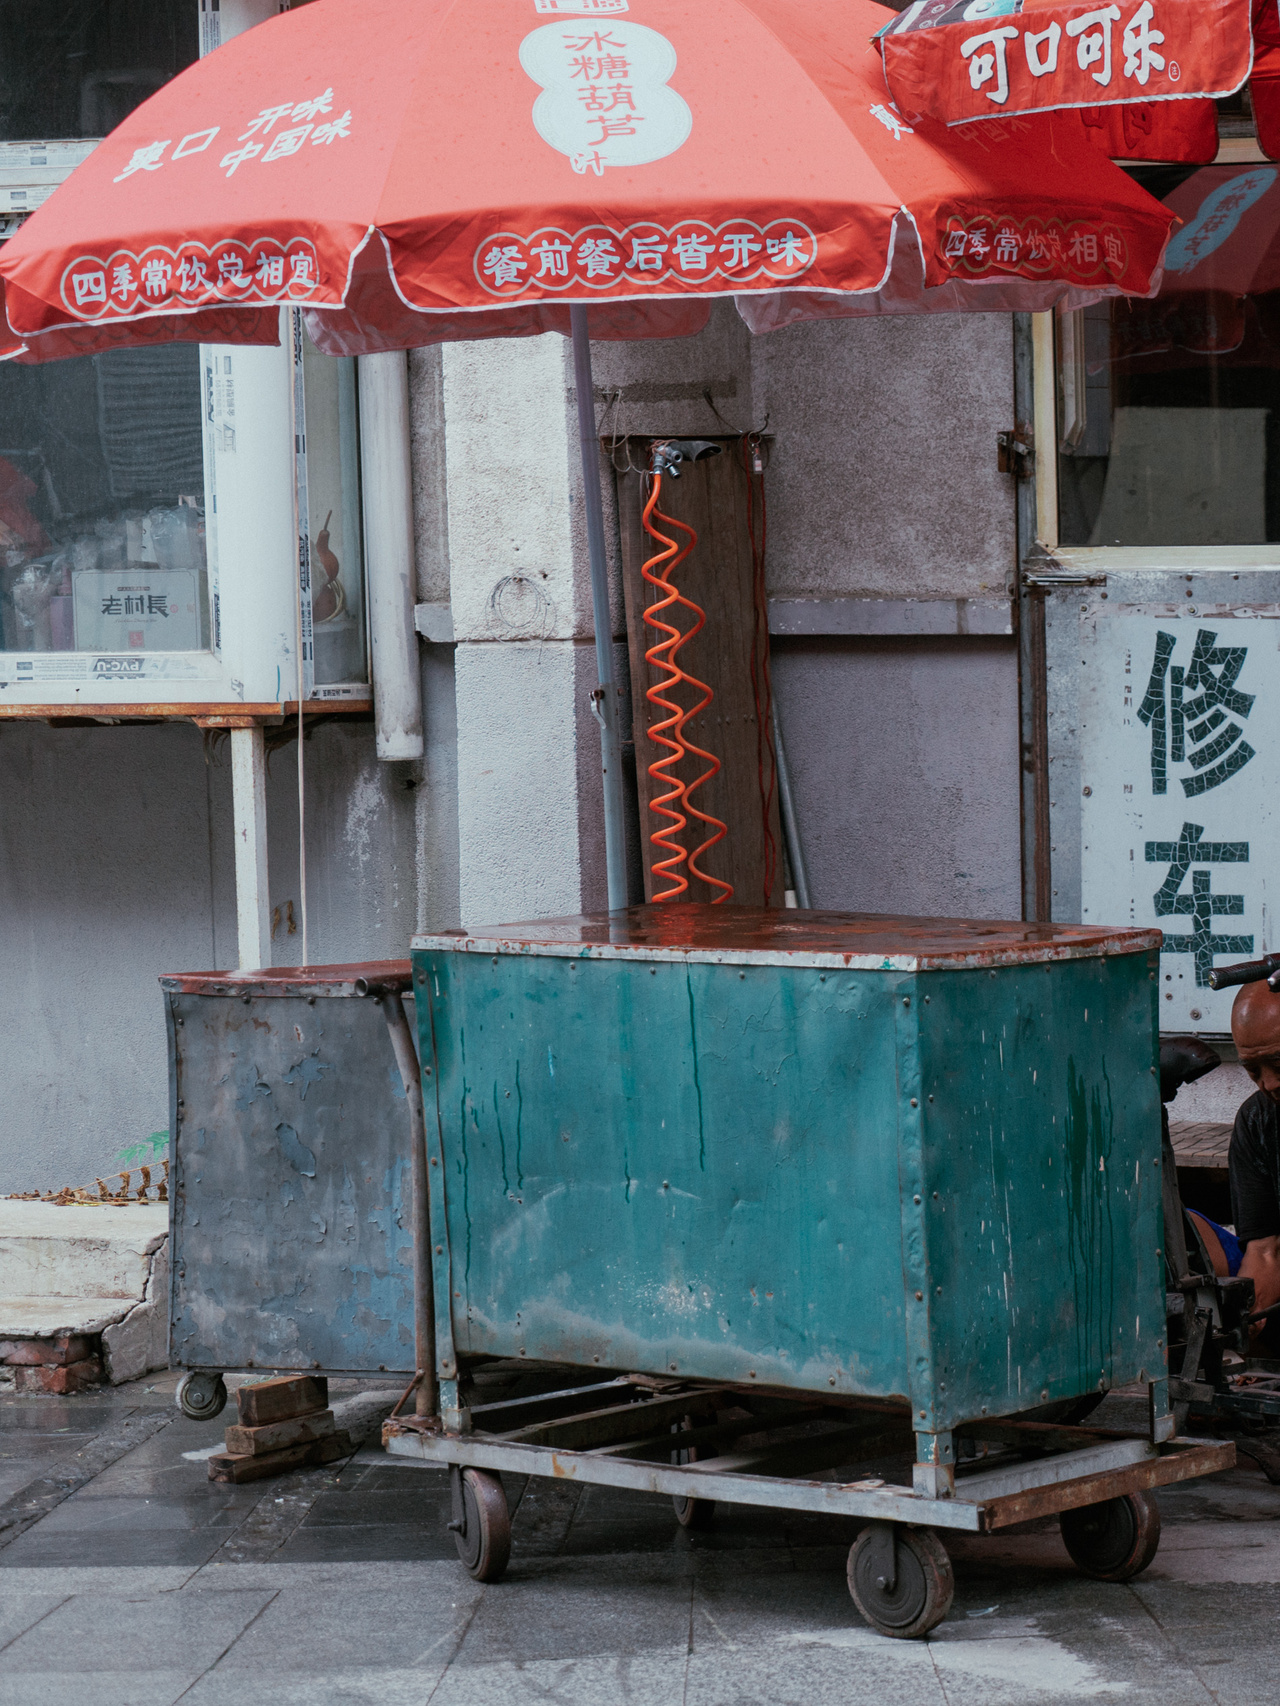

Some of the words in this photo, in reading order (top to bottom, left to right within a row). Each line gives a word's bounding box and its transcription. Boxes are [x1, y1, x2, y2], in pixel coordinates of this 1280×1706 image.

[960, 1, 1165, 104] 可口可乐
[238, 87, 334, 141] 开味
[113, 126, 220, 182] 爽口
[219, 110, 352, 177] 中国味
[71, 250, 320, 306] 四季常饮总相宜
[483, 230, 809, 287] 餐前餐后皆开味
[1137, 628, 1256, 989] 修车
